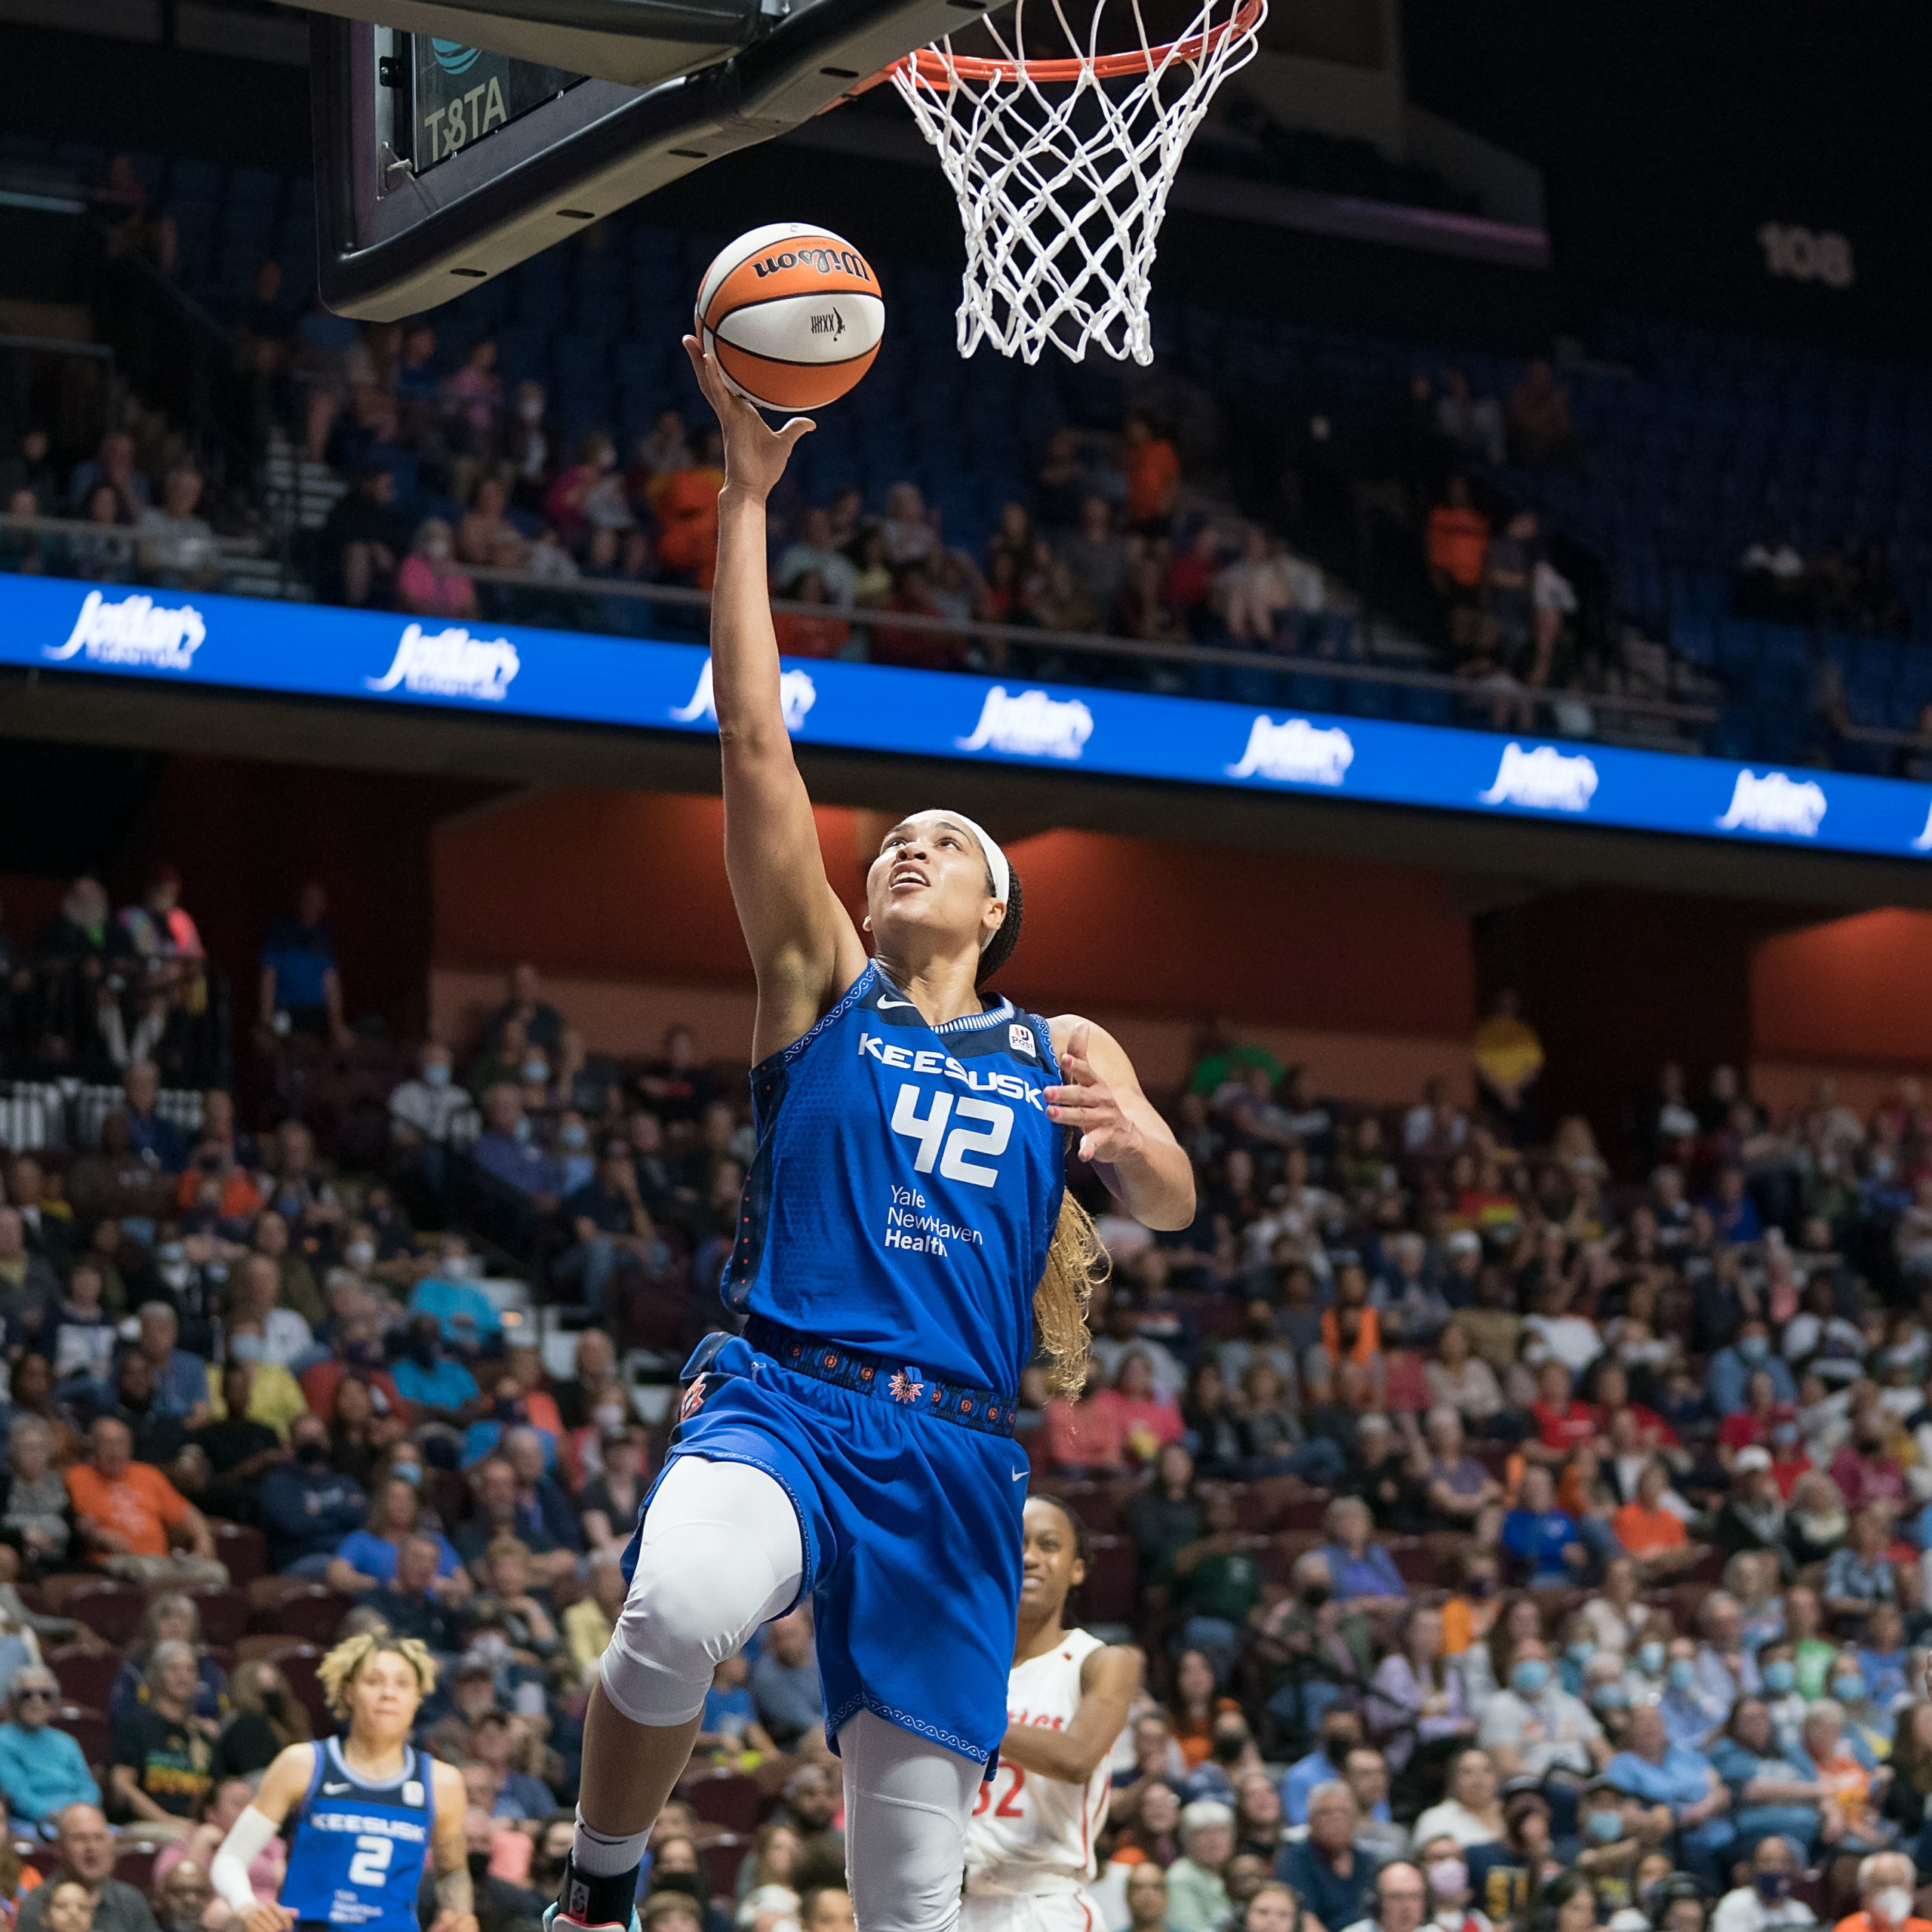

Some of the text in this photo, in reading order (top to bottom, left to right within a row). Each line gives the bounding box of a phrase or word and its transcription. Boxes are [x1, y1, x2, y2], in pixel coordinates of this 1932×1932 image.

[752, 248, 871, 283] Wilson
[858, 1032, 1044, 1111] KEESUSK
[891, 1083, 1014, 1188] 42
[891, 1185, 926, 1208] Yale
[884, 1229, 948, 1257] Health
[348, 1835, 394, 1887] 2
